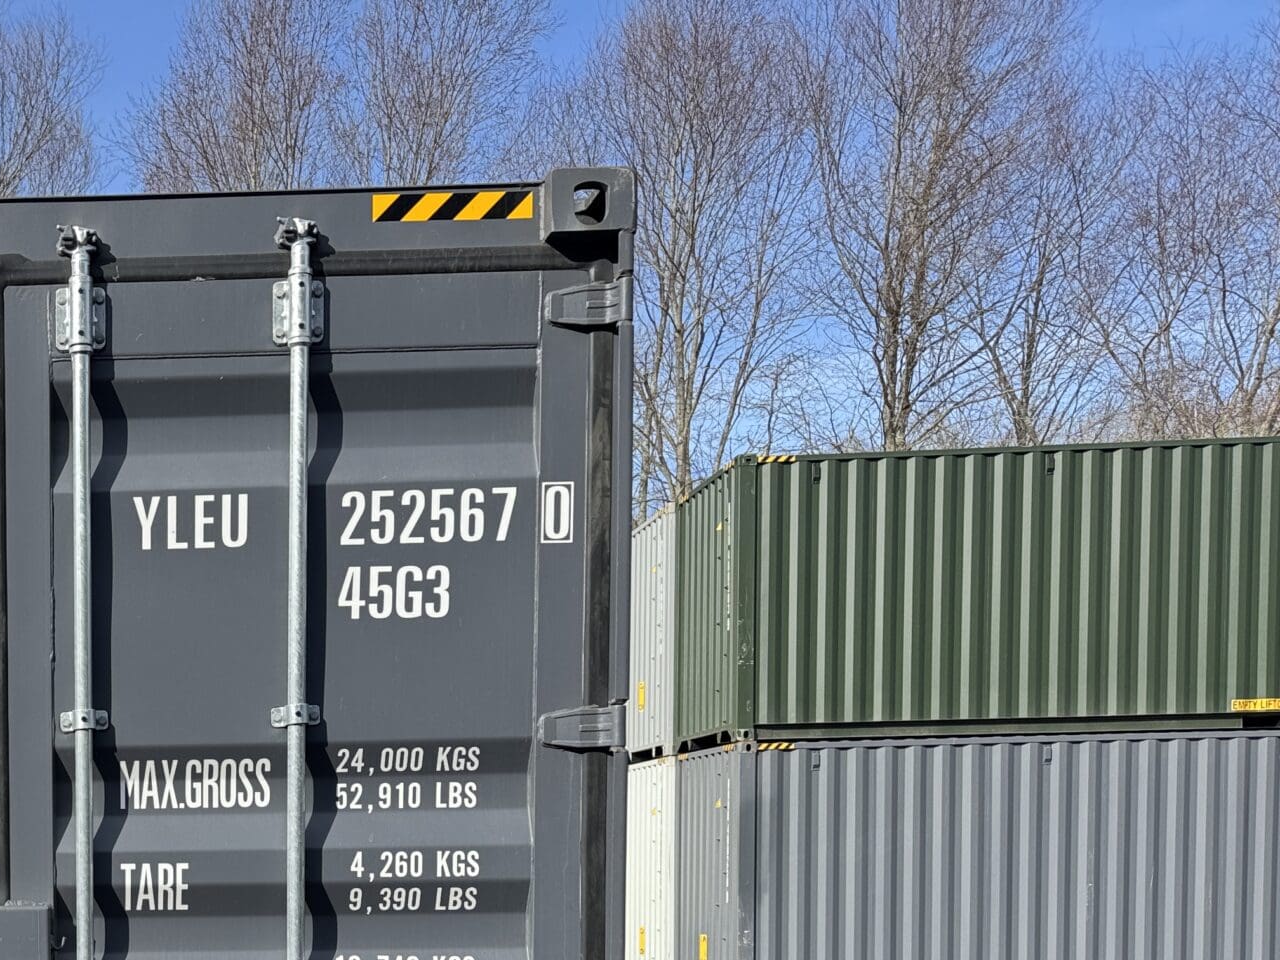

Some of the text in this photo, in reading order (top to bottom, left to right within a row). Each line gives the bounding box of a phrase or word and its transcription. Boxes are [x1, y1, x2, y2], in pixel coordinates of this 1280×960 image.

[133, 484, 570, 550] YLEU 252567 0
[337, 565, 450, 620] 45G3
[120, 746, 480, 809] MAX.GROSS 24,000 KGS
[336, 781, 477, 814] 52,910 LBS
[120, 850, 480, 910] TARE 4,260 KGS
[349, 886, 477, 915] 9,390 LBS
